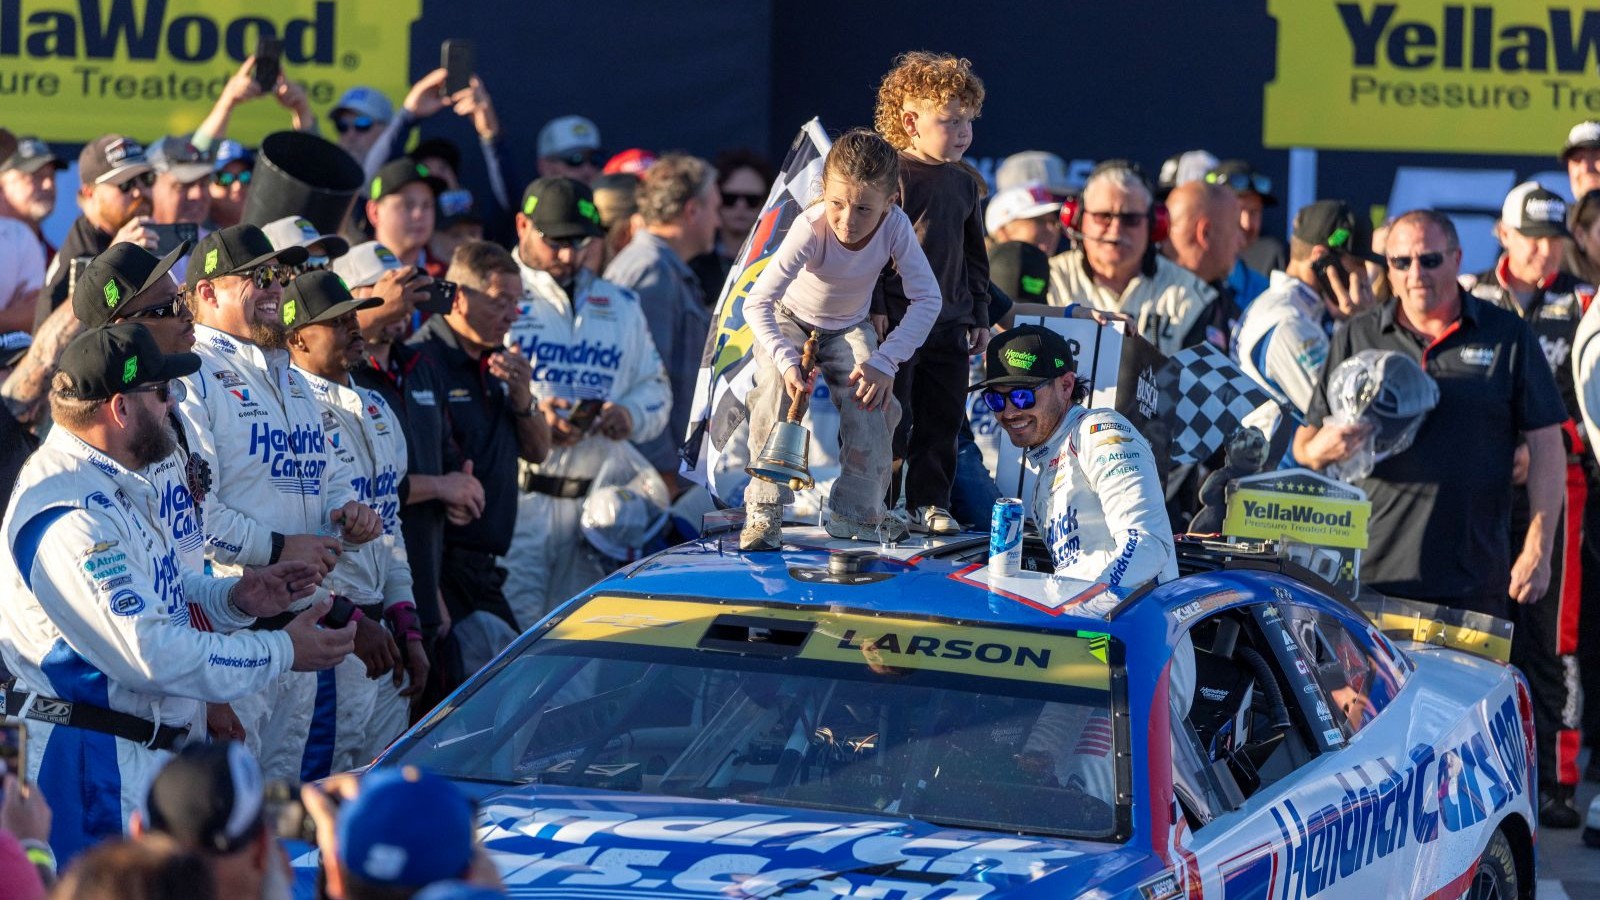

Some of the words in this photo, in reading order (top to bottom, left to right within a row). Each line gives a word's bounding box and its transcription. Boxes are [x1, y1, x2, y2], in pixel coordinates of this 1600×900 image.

[1350, 75, 1531, 110] Pressure
[516, 335, 622, 370] Hendrick
[1136, 375, 1159, 414] BUSCH
[249, 422, 326, 463] Hendrick
[1109, 451, 1140, 461] Atrium
[1104, 465, 1140, 478] SIEMENS
[1243, 500, 1352, 527] YellaWood
[1245, 519, 1287, 531] Pressure
[1291, 523, 1327, 535] Treated
[1329, 527, 1350, 537] Pine
[93, 564, 127, 580] SIEMENS
[97, 552, 126, 567] Atrium
[1172, 600, 1204, 623] KYLE
[837, 629, 1051, 669] LARSON
